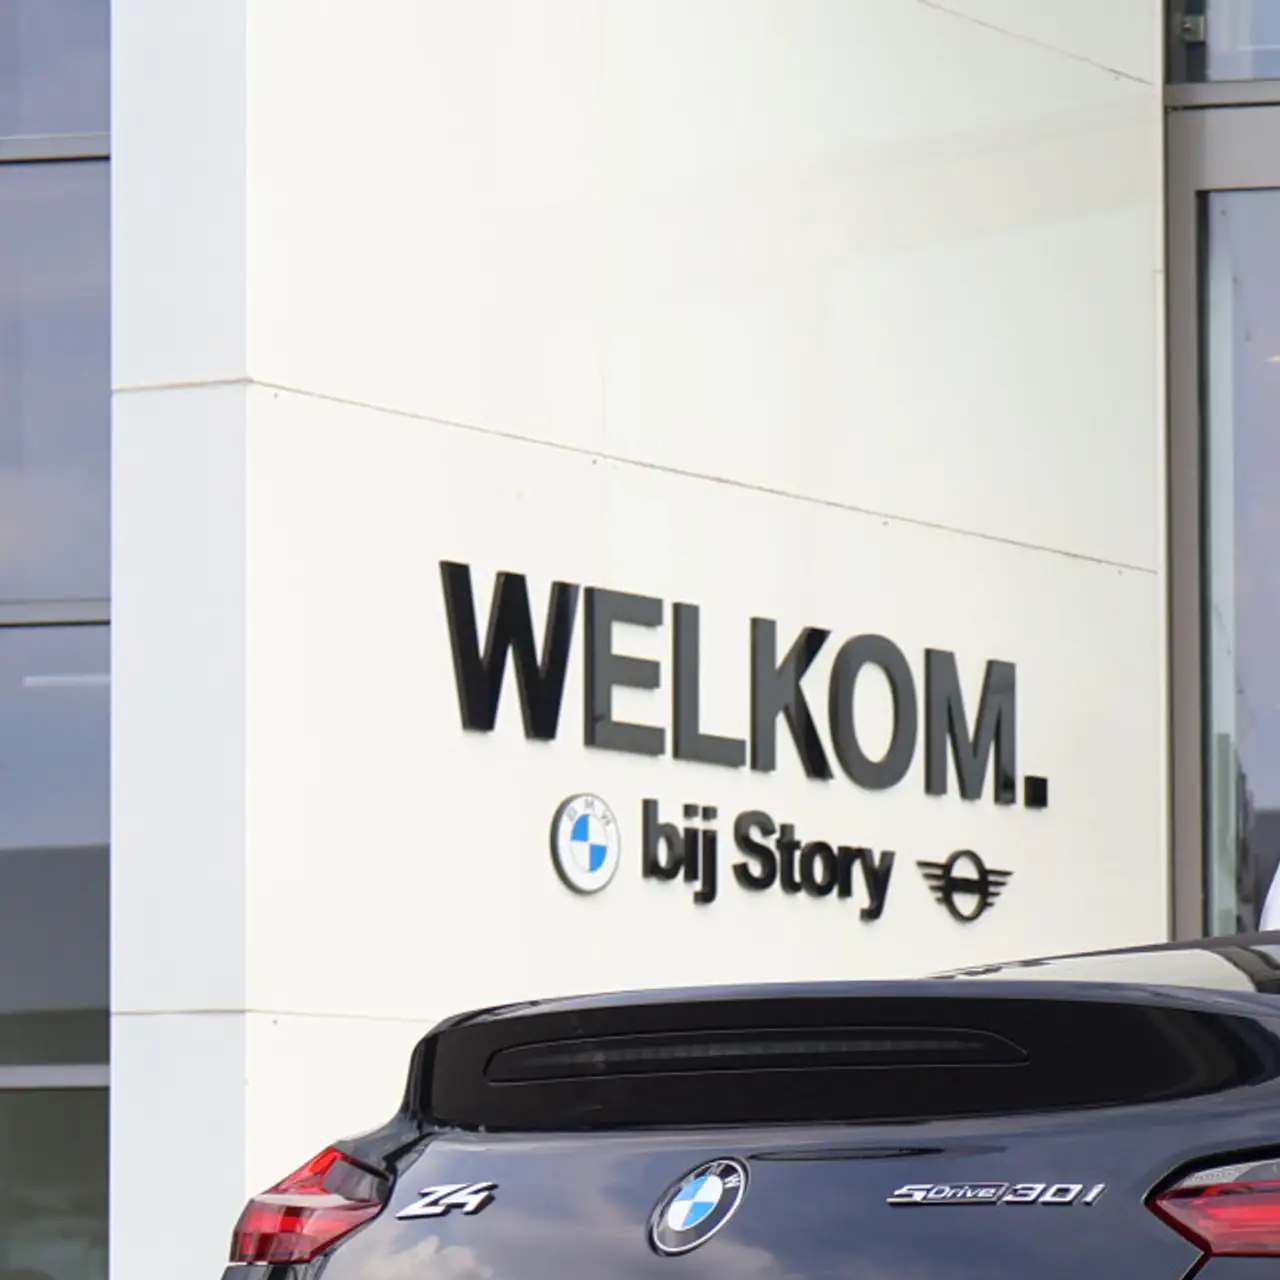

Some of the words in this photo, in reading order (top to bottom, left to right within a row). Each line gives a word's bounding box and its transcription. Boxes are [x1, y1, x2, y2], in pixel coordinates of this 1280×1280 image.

[439, 560, 1048, 808] WELKOM.
[641, 797, 718, 905] bij
[732, 810, 896, 922] Story
[395, 1181, 498, 1220] Z4
